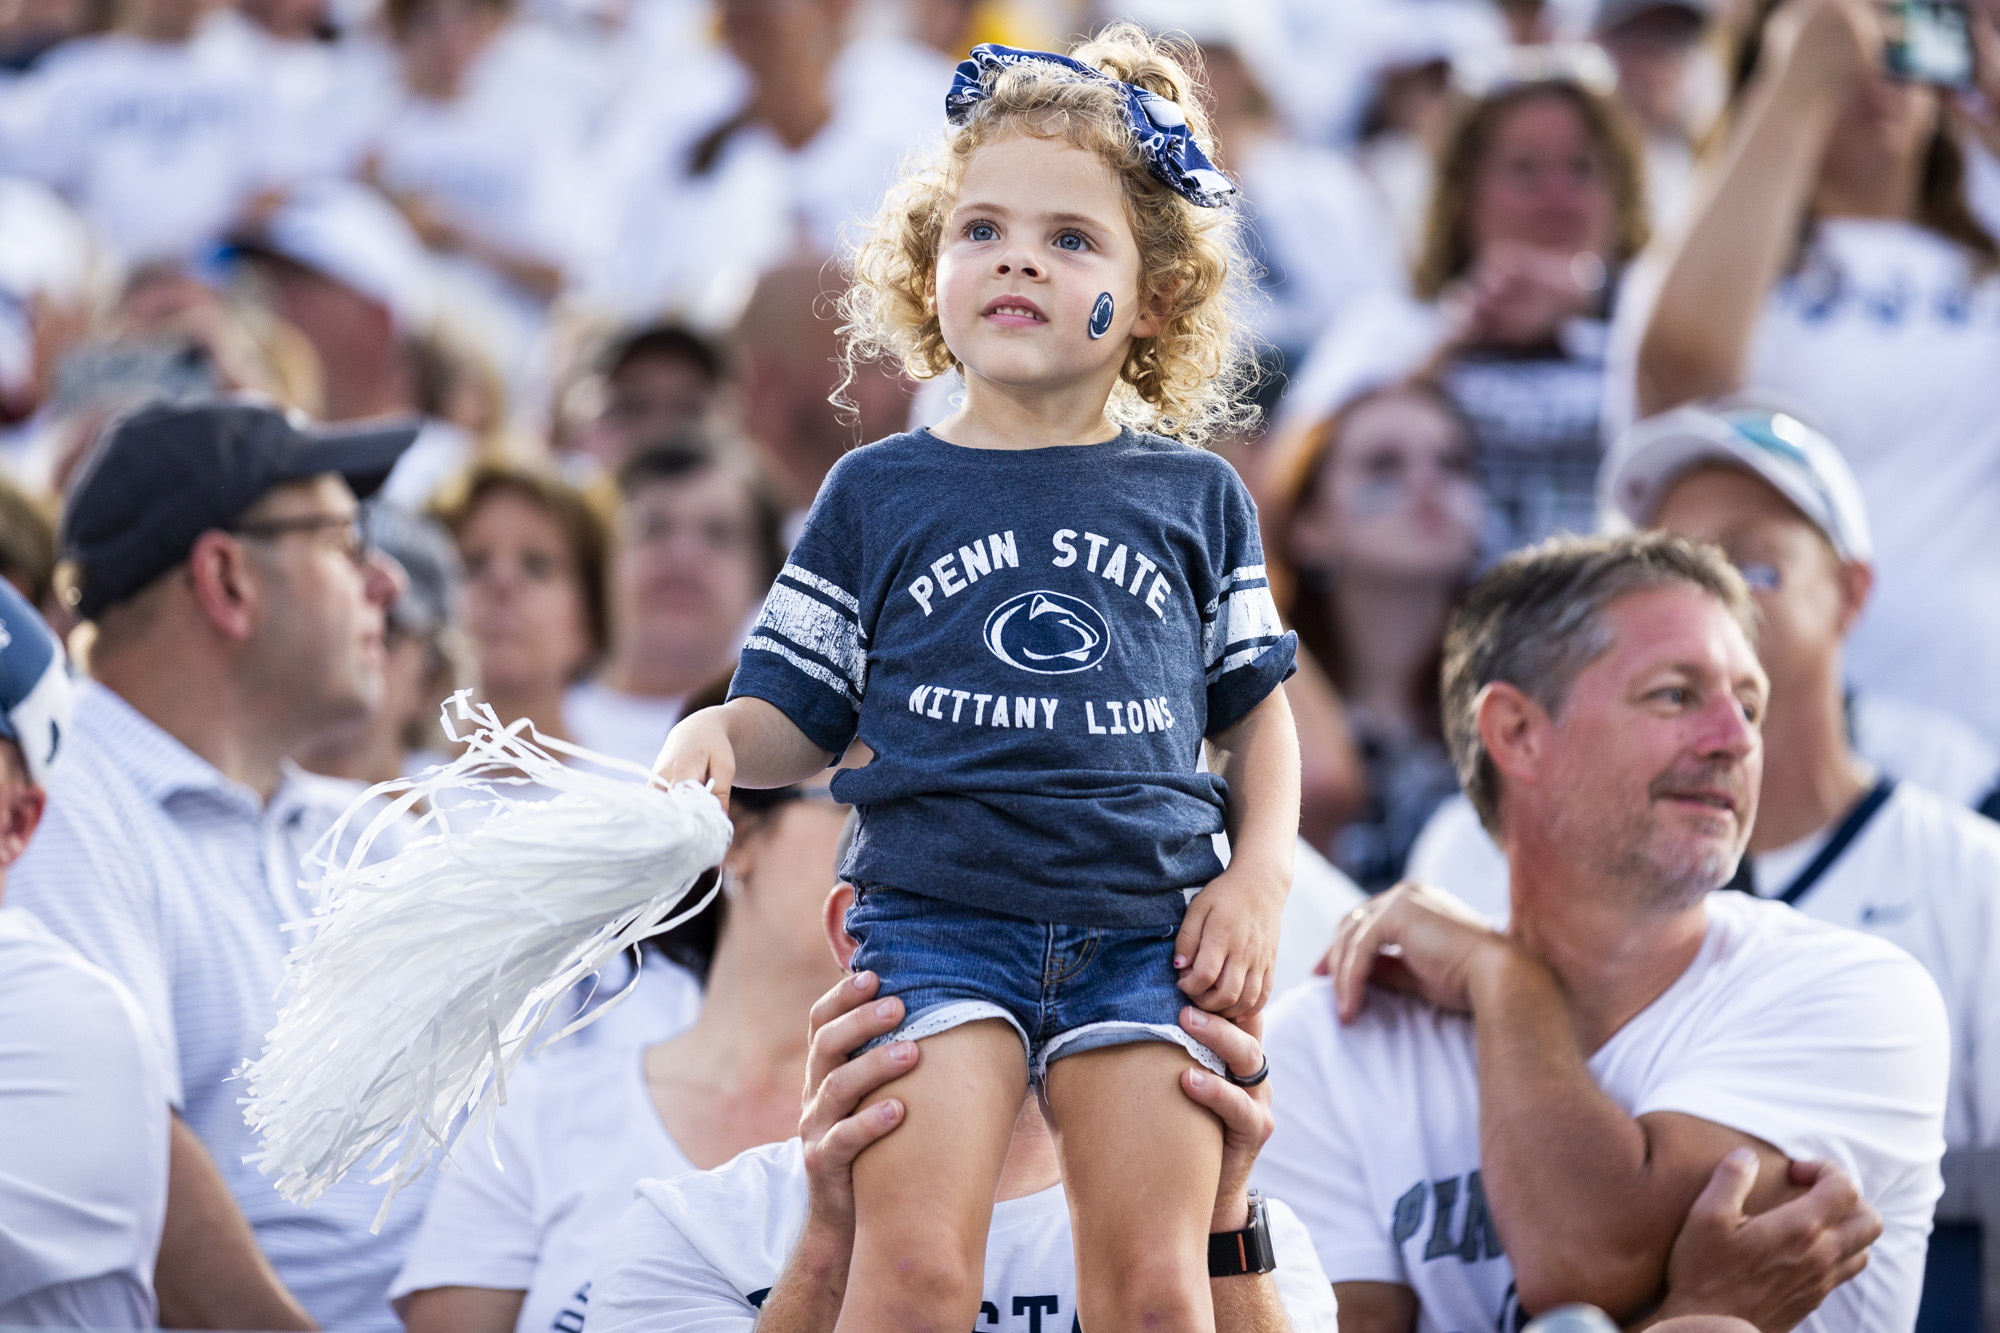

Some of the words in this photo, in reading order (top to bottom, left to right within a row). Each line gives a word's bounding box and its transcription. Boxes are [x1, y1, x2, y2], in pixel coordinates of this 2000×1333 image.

[908, 530, 1020, 617] PENN
[1052, 528, 1172, 619] STATE
[908, 684, 1059, 730] NITTANY
[1085, 696, 1175, 735] LIONS
